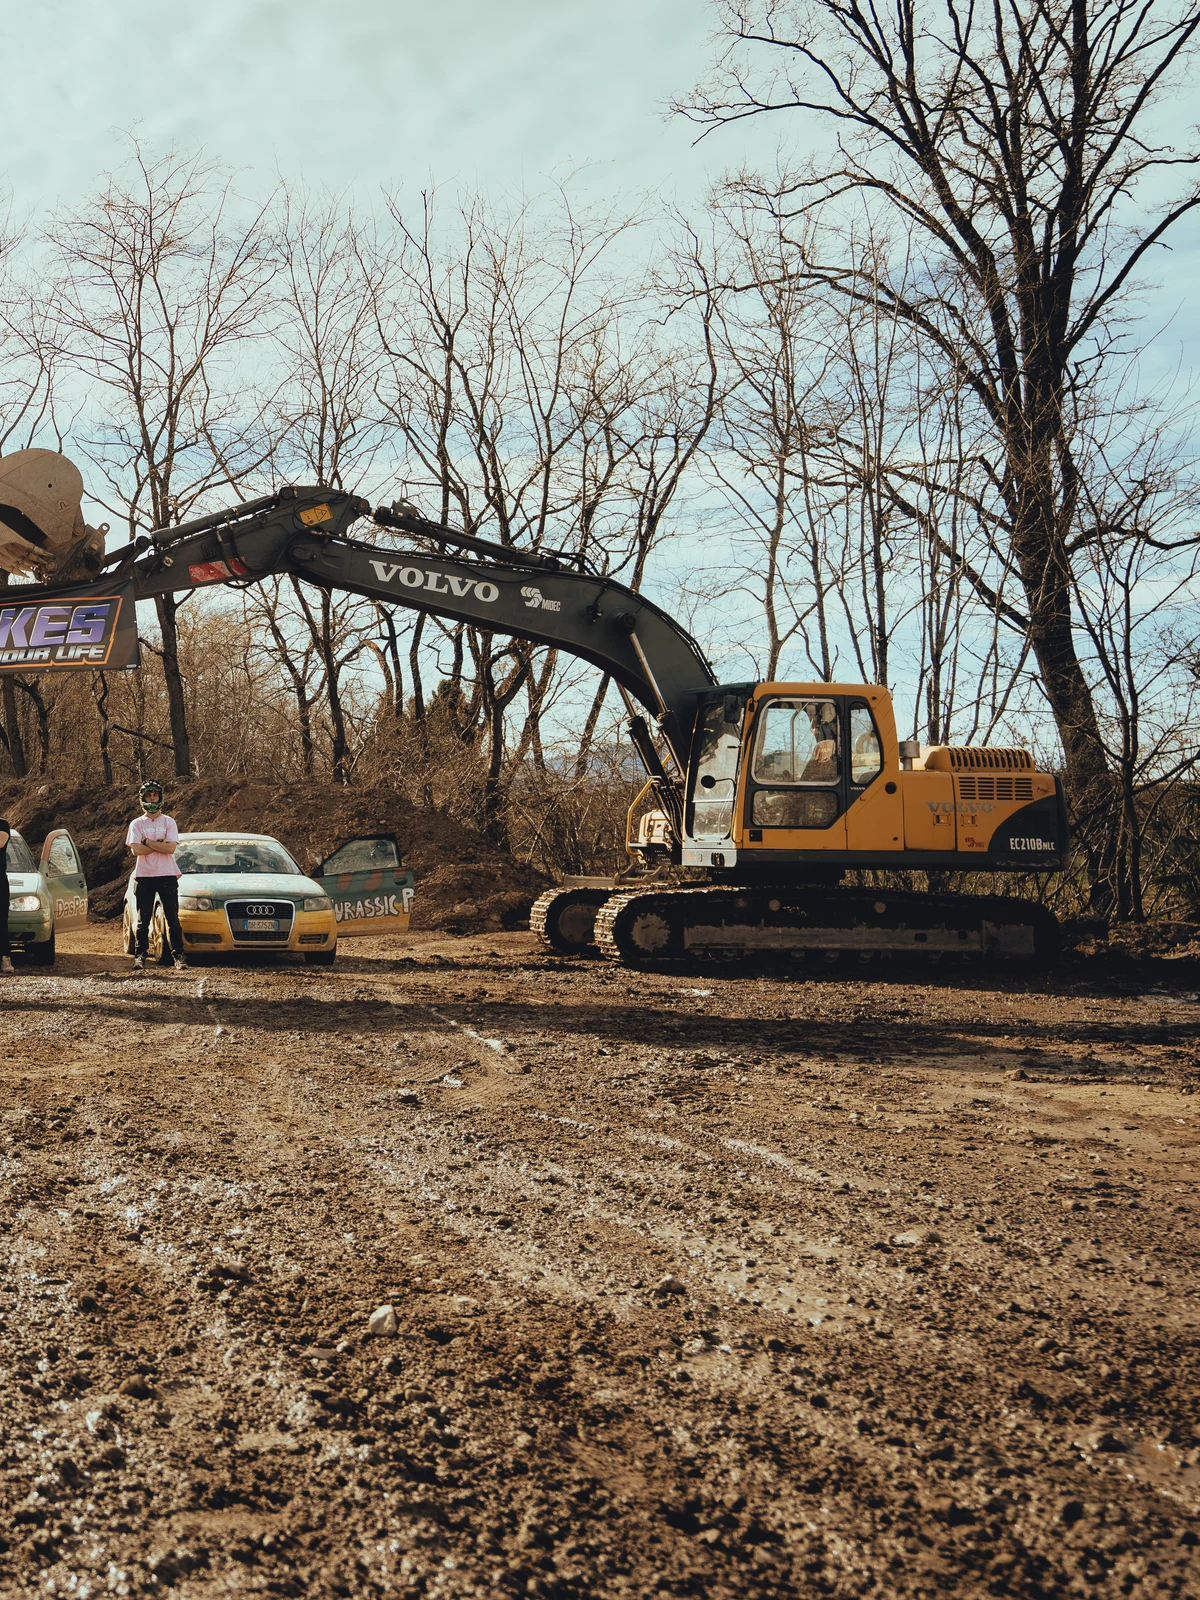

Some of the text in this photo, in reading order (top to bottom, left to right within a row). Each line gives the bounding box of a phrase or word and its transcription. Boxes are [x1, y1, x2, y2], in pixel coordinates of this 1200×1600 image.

[369, 560, 499, 602] VOLVO
[541, 599, 561, 612] MIDEC
[54, 645, 105, 660] LIFE
[925, 801, 993, 814] VOLVO
[56, 895, 87, 920] DasPa
[332, 894, 400, 923] URASSIC
